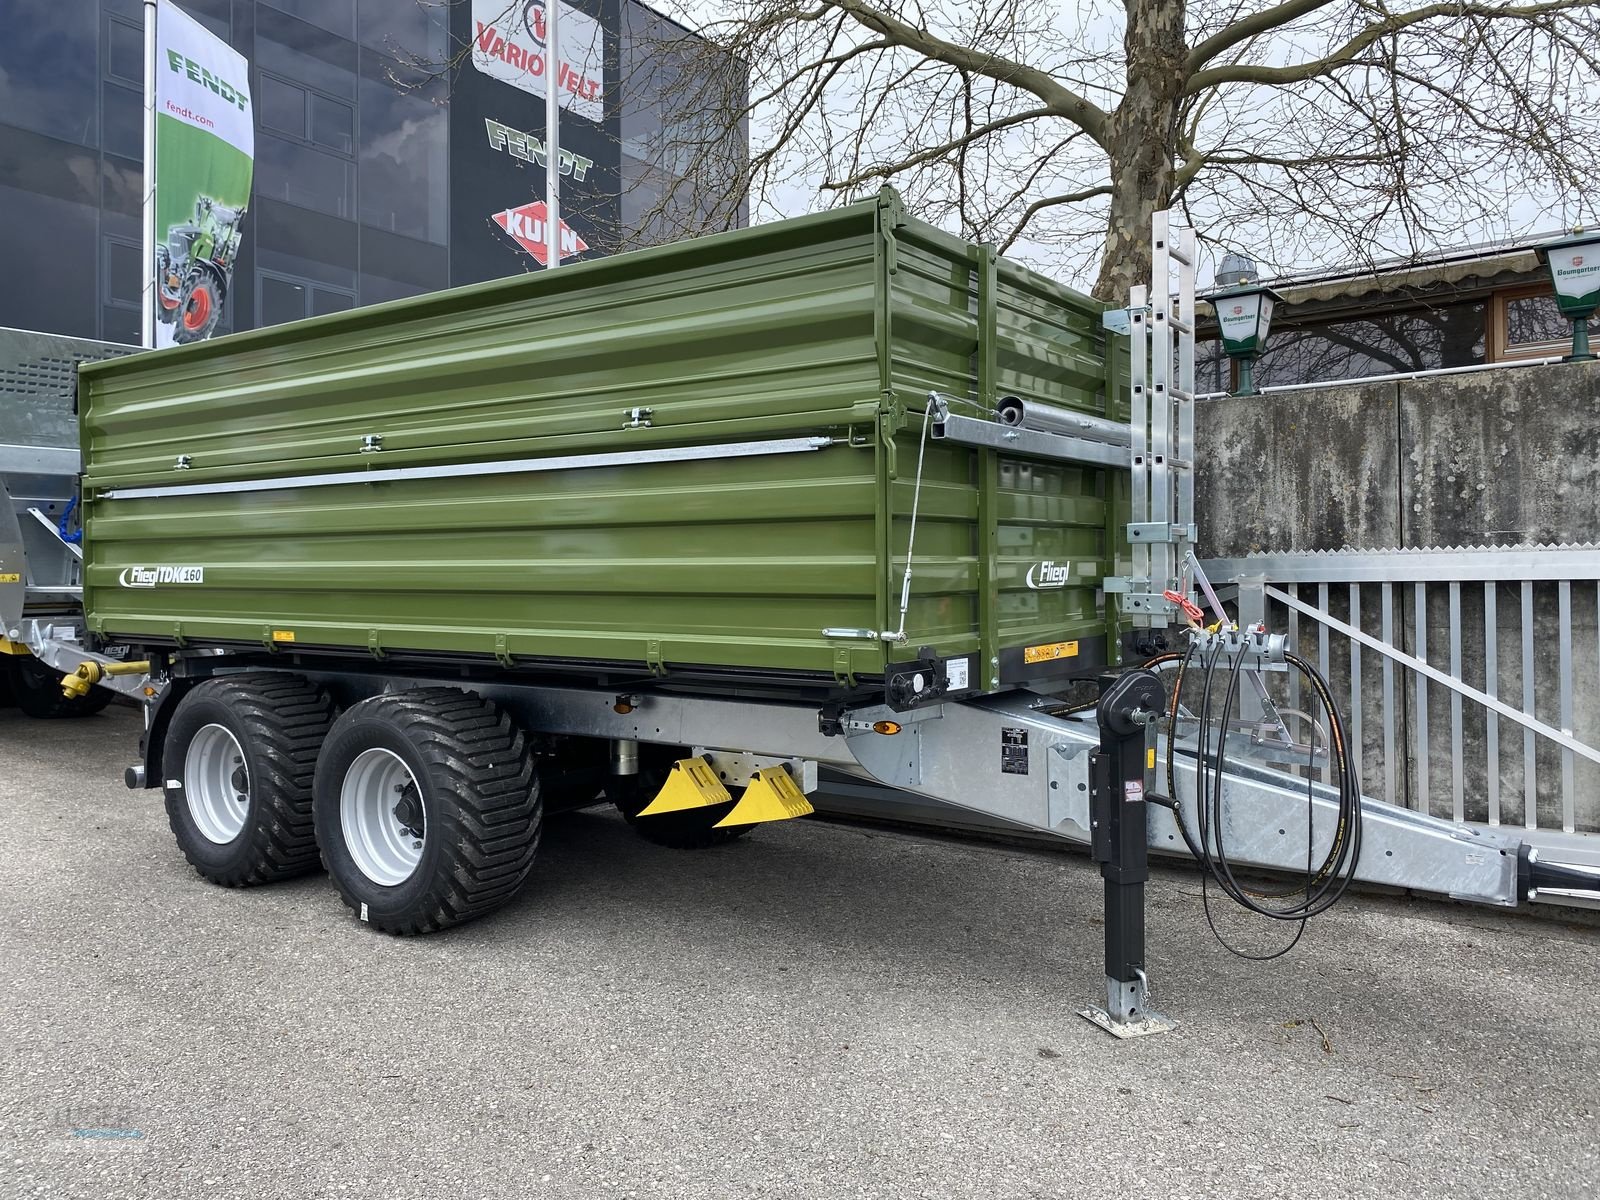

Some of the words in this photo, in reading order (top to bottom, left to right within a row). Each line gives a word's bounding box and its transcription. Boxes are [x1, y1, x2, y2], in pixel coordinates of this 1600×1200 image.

[167, 48, 248, 112] FENDT
[166, 100, 214, 128] fendt.com
[506, 208, 578, 256] KUN
[130, 566, 160, 587] Fliegl
[159, 566, 183, 583] TDK
[183, 569, 202, 582] 160
[1039, 560, 1070, 586] Fliegl
